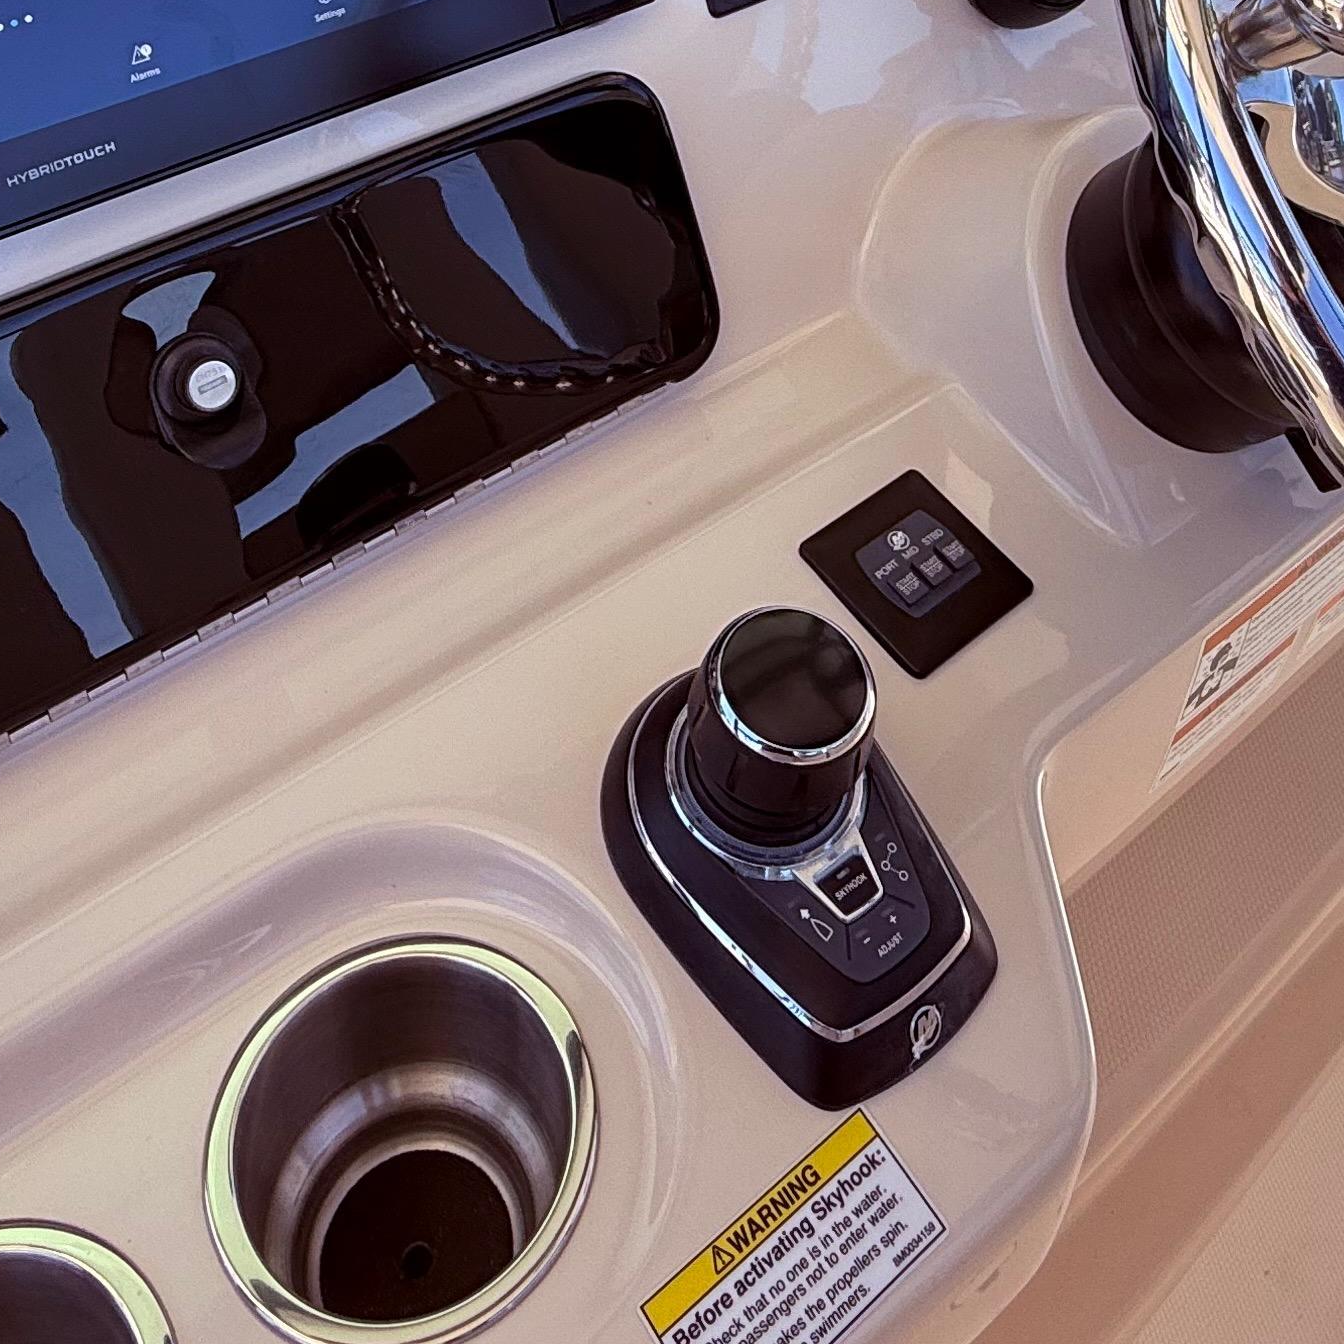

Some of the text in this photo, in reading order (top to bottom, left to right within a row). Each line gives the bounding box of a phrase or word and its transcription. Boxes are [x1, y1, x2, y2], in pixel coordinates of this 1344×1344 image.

[314, 6, 346, 23] Settings
[130, 67, 161, 83] Alarms
[6, 141, 117, 188] HYBRIDTOUCH
[874, 559, 899, 579] PORT
[834, 873, 868, 901] SKYHOOK
[877, 932, 903, 957] ADJUST
[725, 1164, 822, 1254] WARNING
[672, 1149, 887, 1344] Before activating Skyhook:
[706, 1184, 888, 1344] heck that no one is in the water.
[738, 1193, 904, 1344] assengers not to enter water.
[776, 1220, 909, 1344] akes the propellers spin.
[809, 1284, 871, 1344] swimmers.
